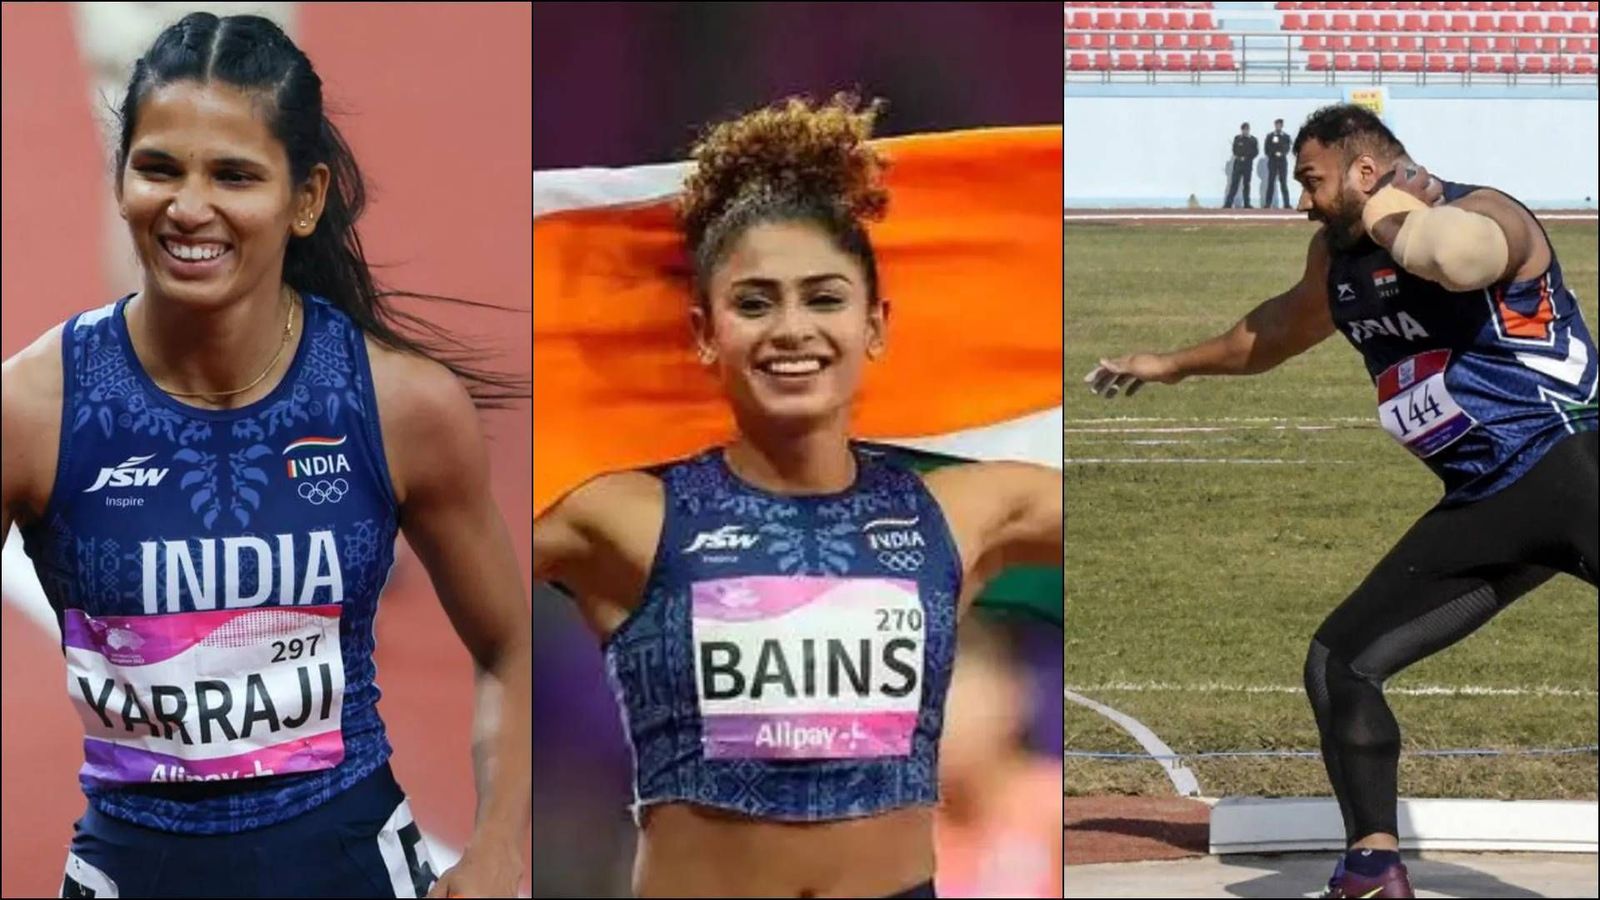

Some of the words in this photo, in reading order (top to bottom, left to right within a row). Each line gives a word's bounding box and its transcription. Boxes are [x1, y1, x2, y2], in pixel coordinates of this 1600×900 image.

[1348, 311, 1430, 344] NDIA
[1391, 384, 1443, 437] 144
[82, 467, 170, 493] JSW
[287, 454, 351, 479] INDIA
[105, 496, 144, 508] Inspire
[869, 531, 924, 550] INDIA
[140, 530, 344, 615] INDIA
[875, 609, 922, 631] 270
[271, 634, 321, 663] 297
[700, 638, 918, 701] BAINS
[78, 663, 333, 746] YARRAJI
